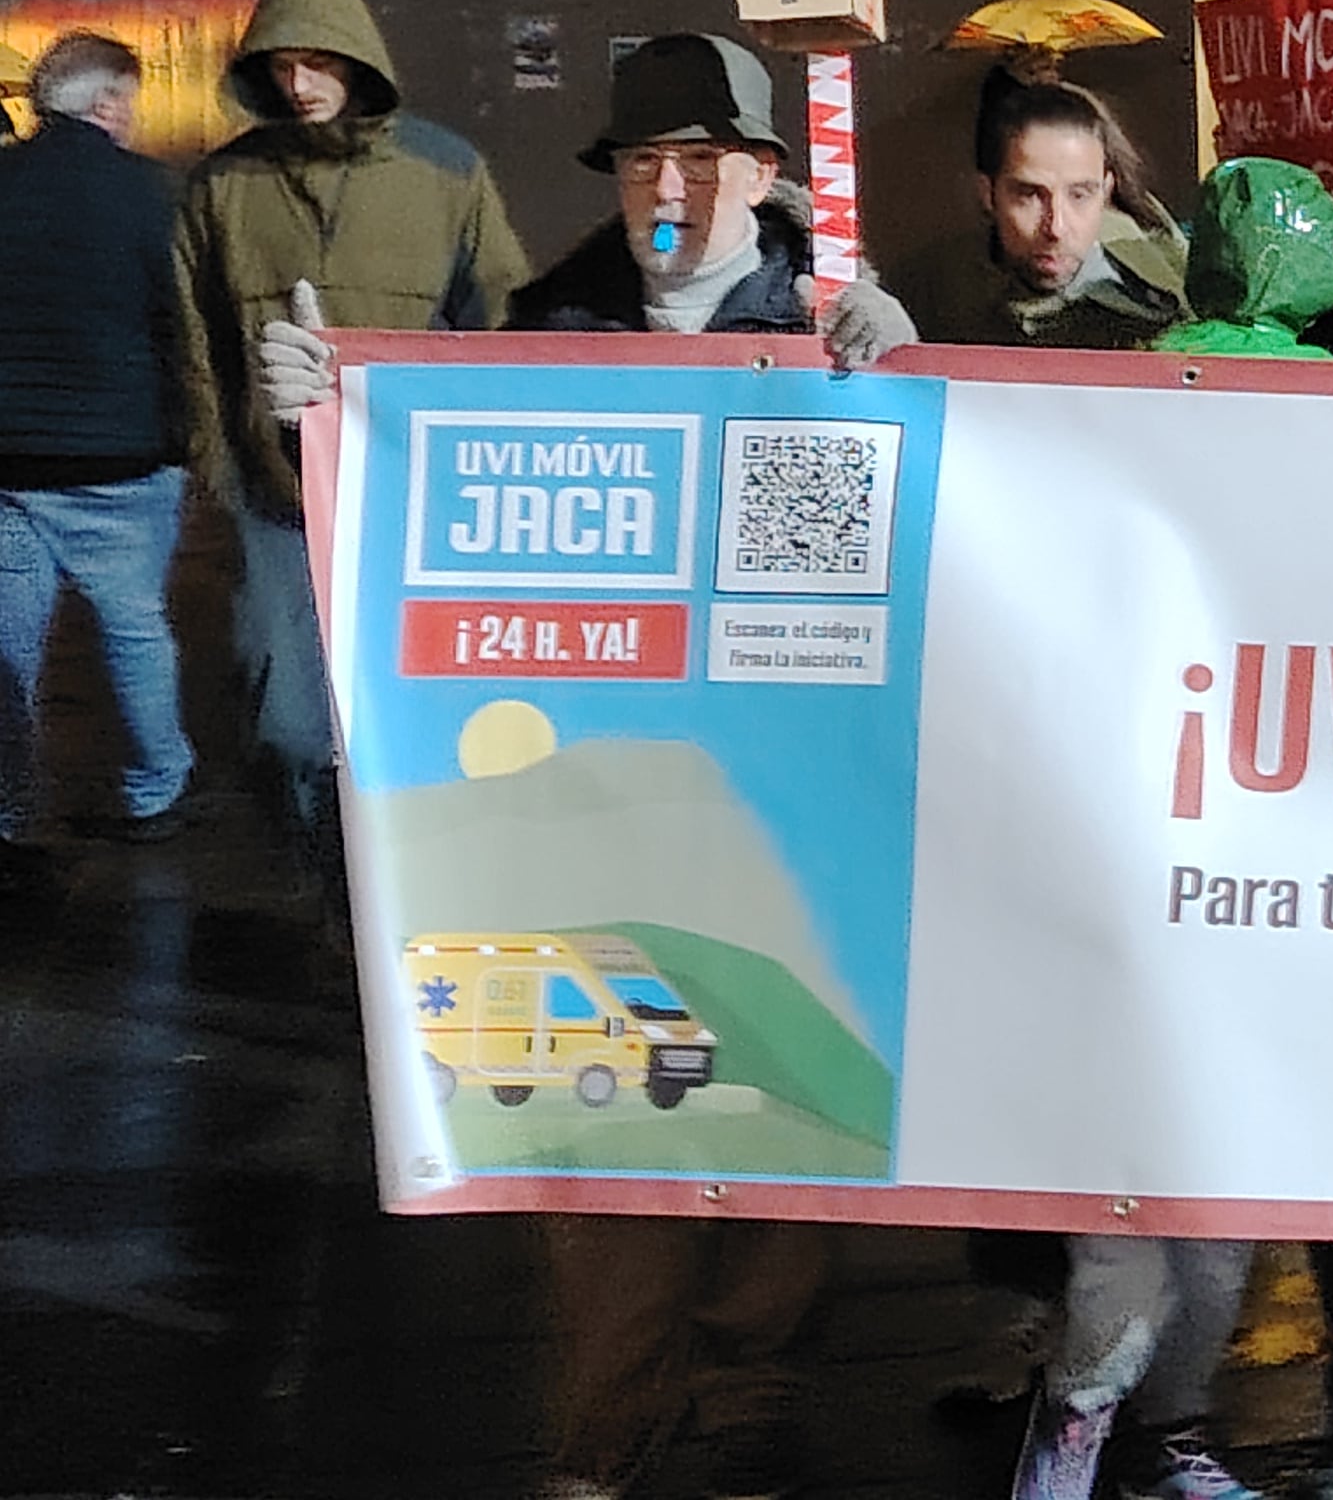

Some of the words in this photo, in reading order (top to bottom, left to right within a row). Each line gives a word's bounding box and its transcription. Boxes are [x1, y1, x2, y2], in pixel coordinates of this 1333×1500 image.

[1216, 13, 1269, 84] UVI
[455, 440, 526, 477] UVI
[533, 434, 656, 479] MÓVIL
[448, 485, 655, 557] JACA
[535, 620, 571, 662] H.
[581, 618, 641, 663] YA!
[724, 619, 787, 638] Escanea
[792, 621, 809, 639] el
[810, 621, 860, 643] código
[774, 651, 789, 667] la
[791, 651, 868, 669] iniciativa.
[1167, 865, 1299, 929] Para
